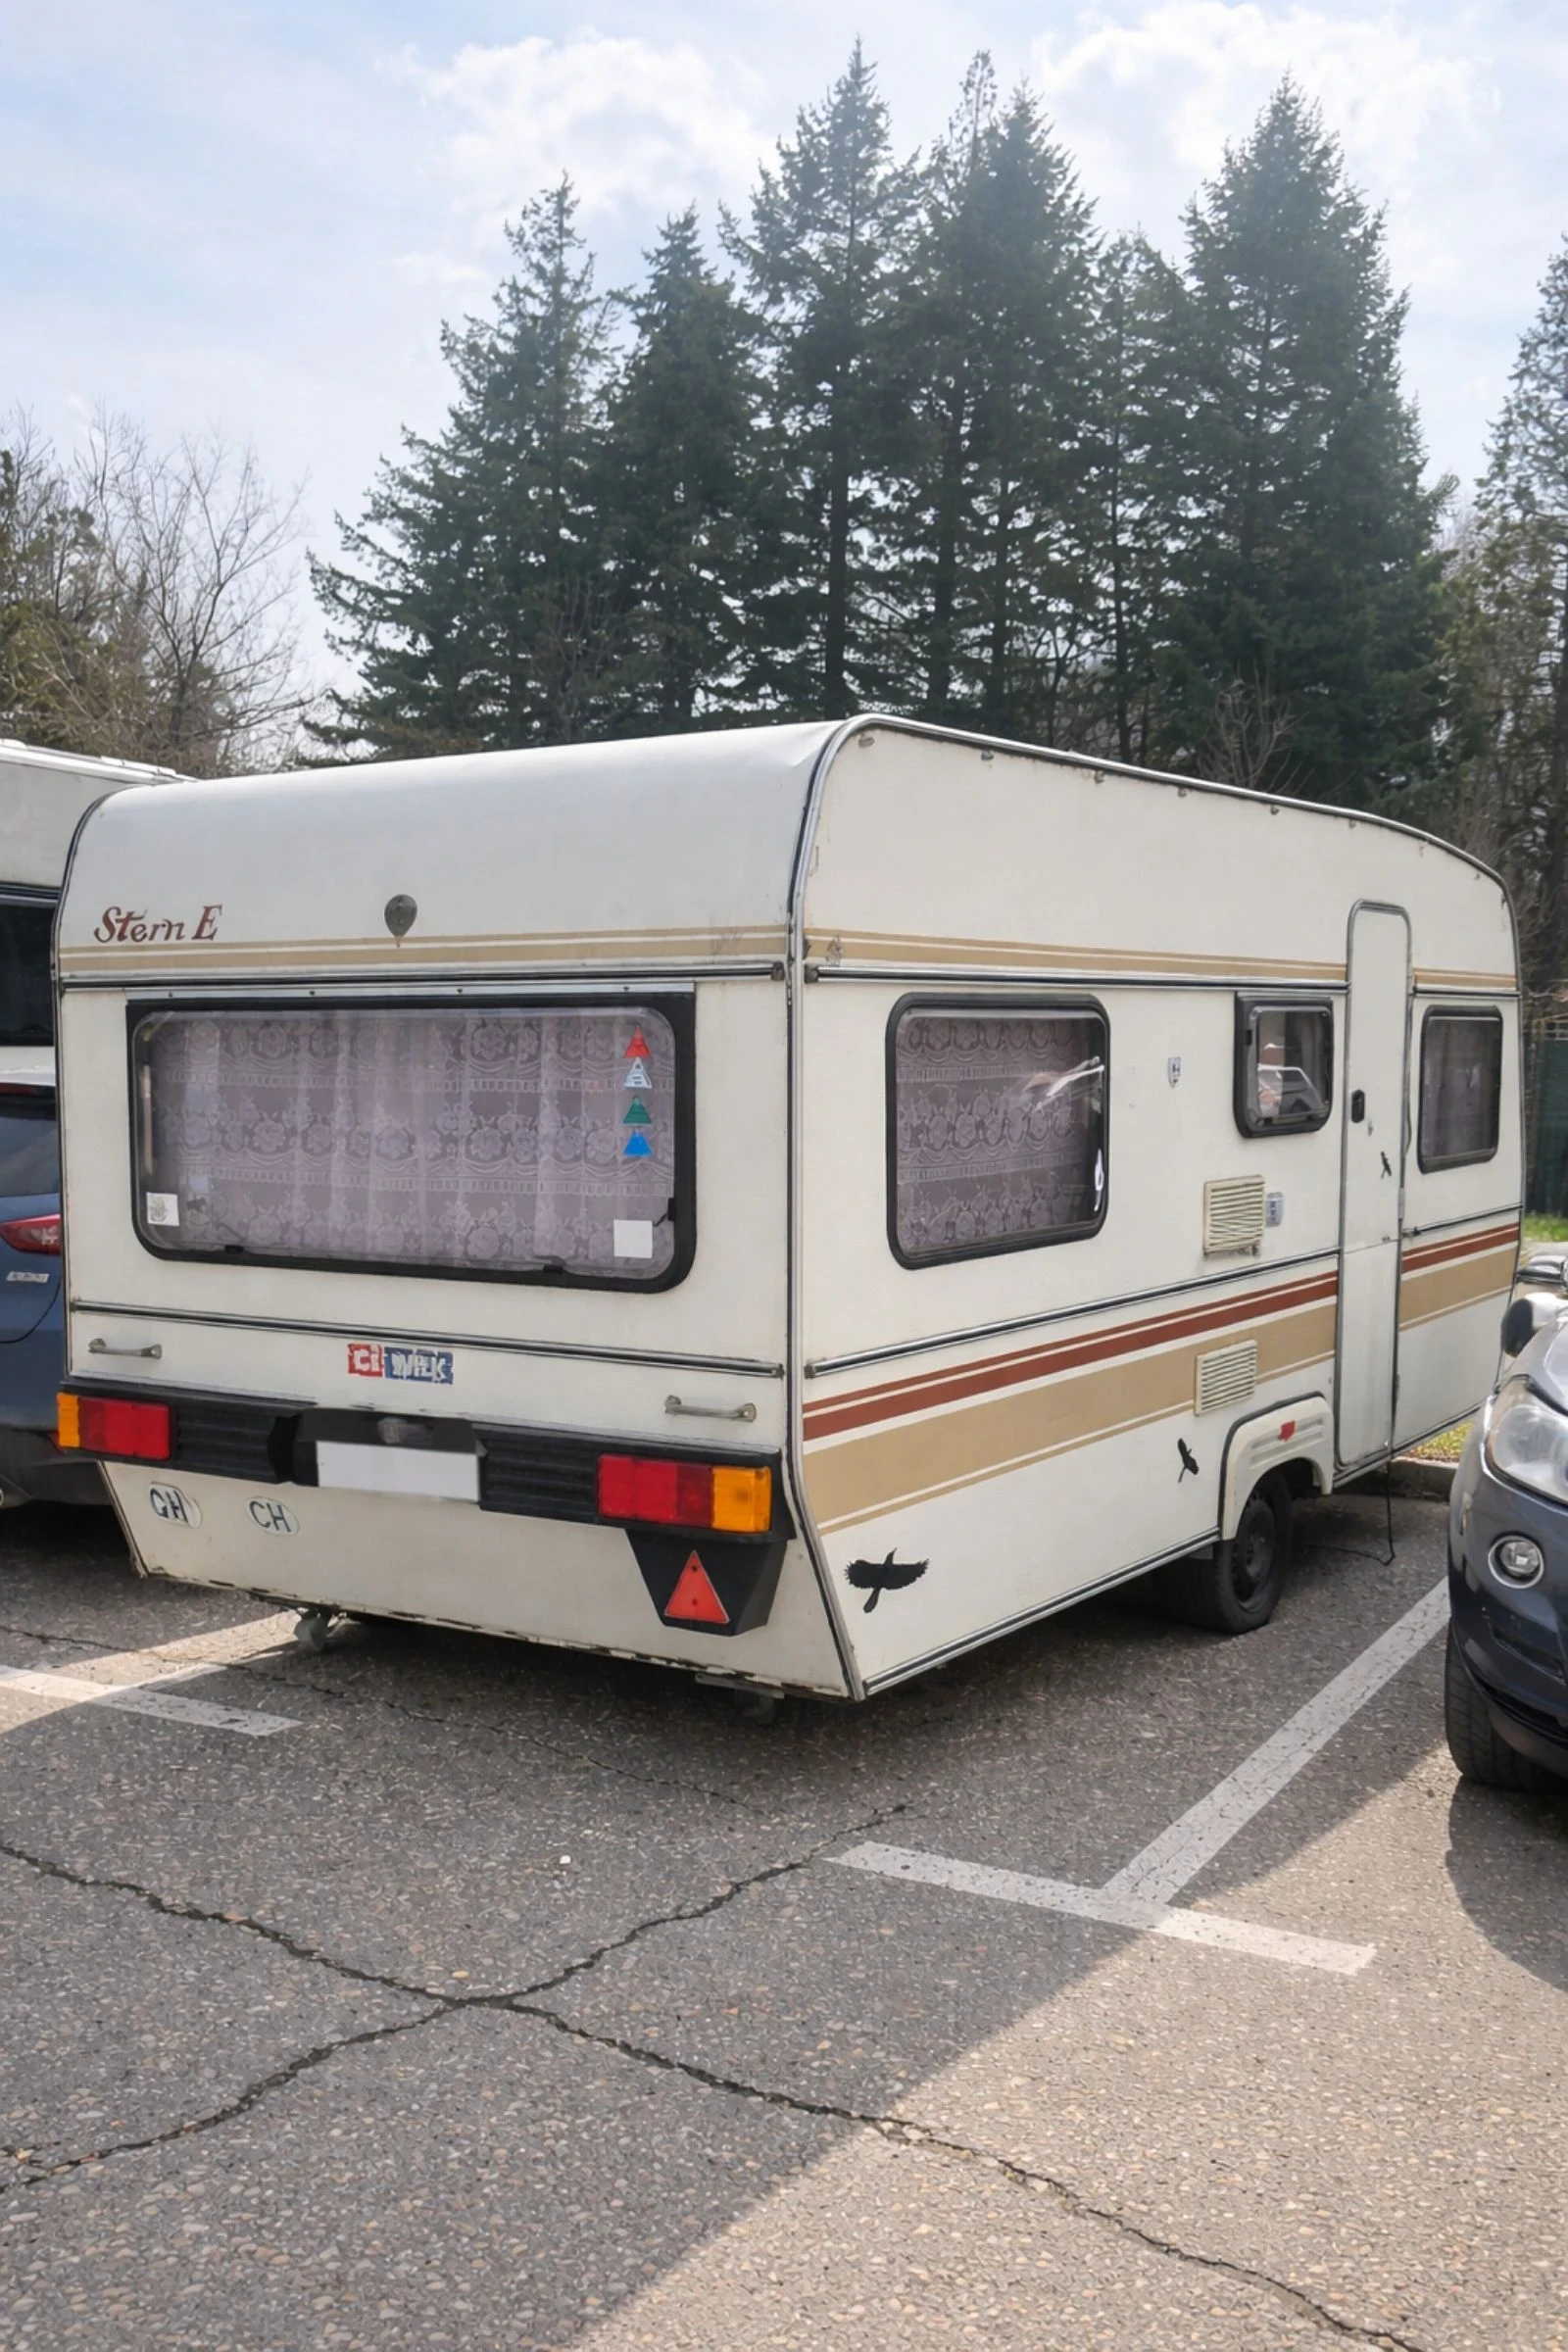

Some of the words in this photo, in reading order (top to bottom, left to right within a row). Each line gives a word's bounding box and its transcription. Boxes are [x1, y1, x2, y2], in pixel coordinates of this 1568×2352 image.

[94, 906, 185, 943] Stern
[191, 904, 222, 941] E
[249, 1500, 292, 1533] CH
